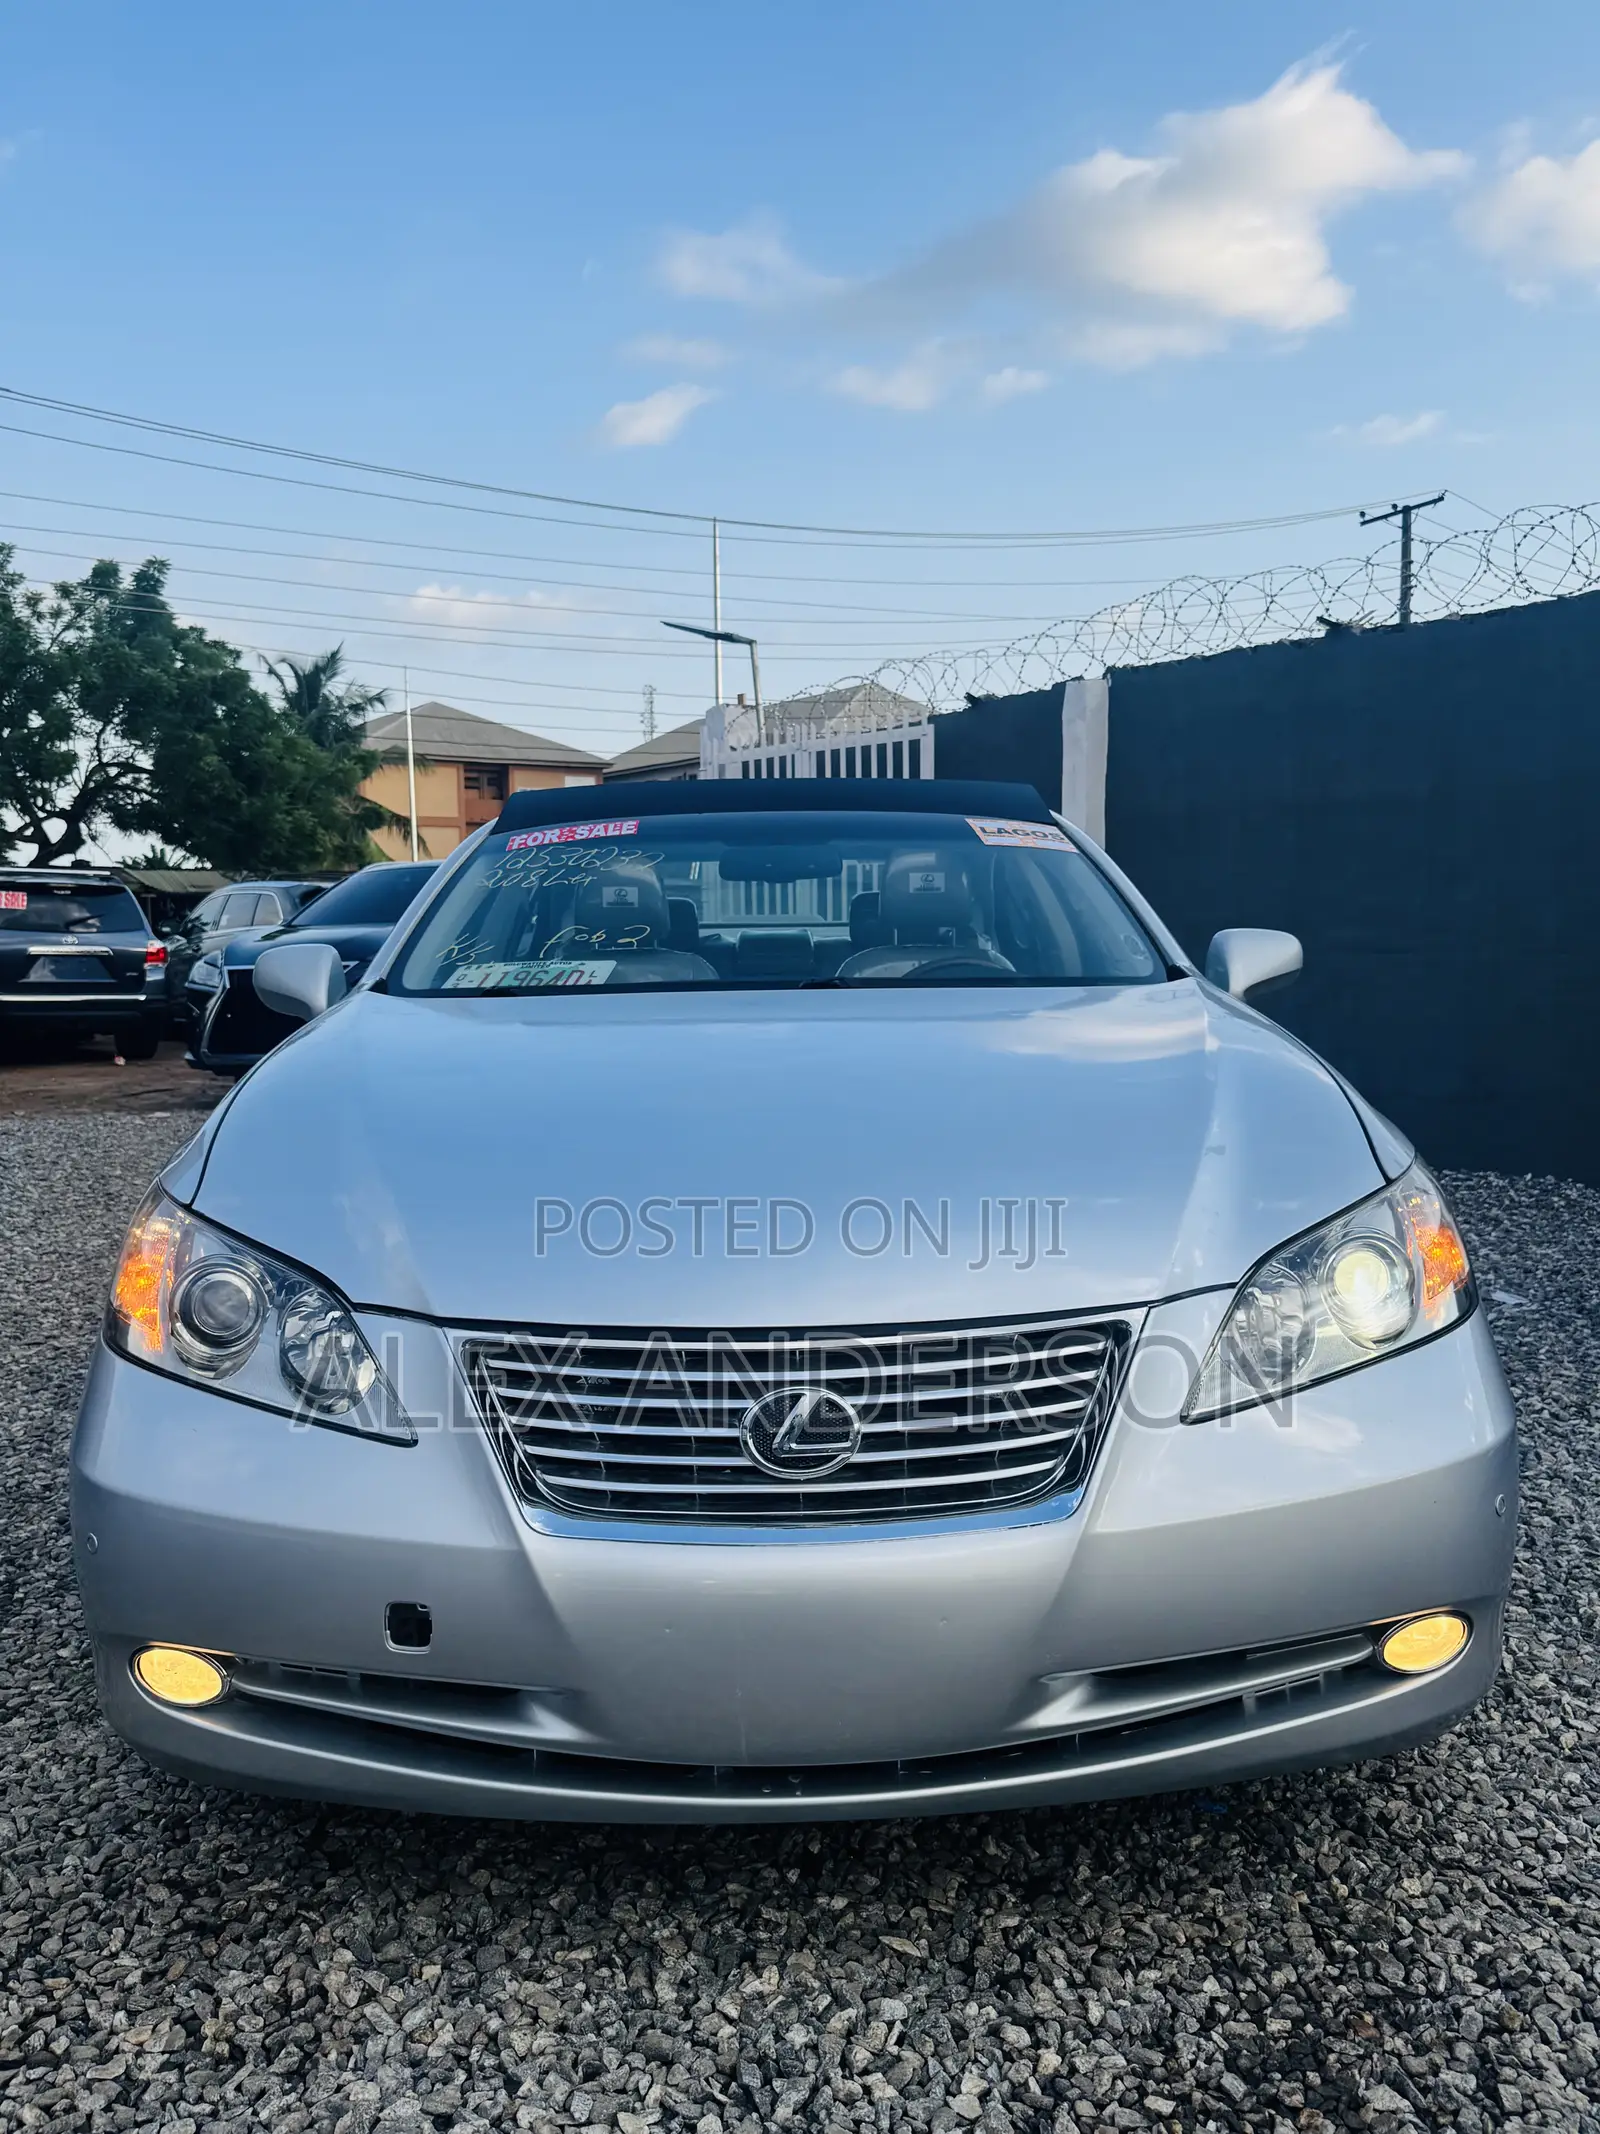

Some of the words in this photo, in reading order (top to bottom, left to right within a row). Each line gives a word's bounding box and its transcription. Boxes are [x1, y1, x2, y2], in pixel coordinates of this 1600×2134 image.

[511, 829, 560, 850] FOR
[575, 820, 637, 840] SALE
[978, 826, 1066, 841] LAGOS
